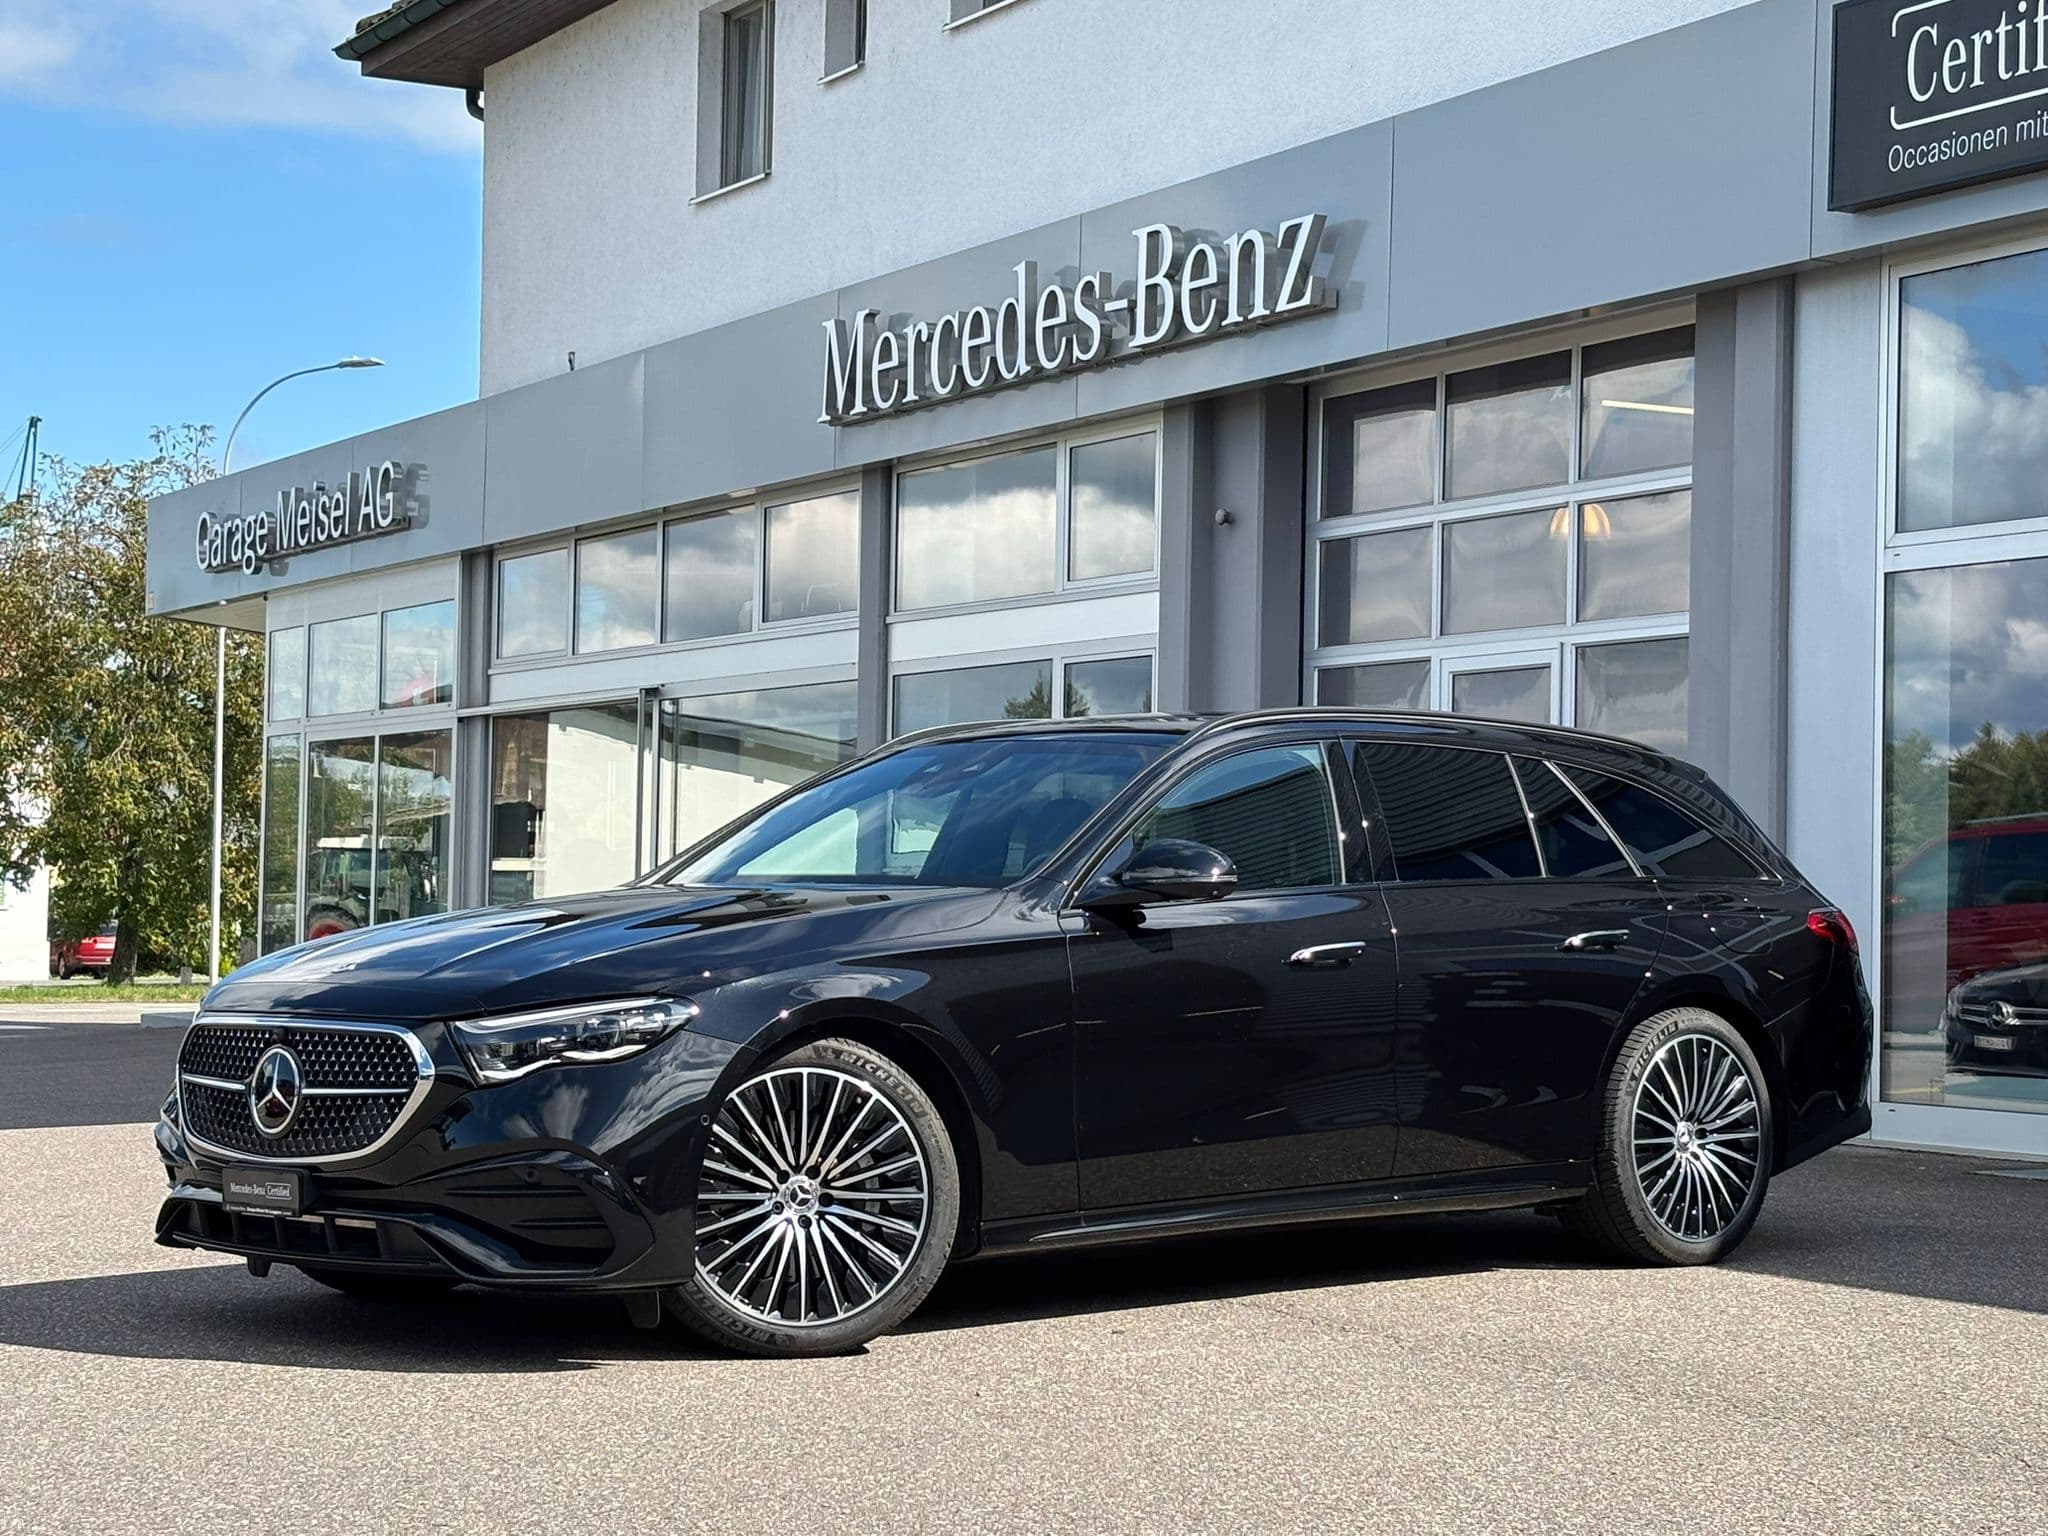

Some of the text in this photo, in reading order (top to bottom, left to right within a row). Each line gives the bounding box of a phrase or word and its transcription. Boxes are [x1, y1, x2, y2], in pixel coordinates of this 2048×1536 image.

[1888, 110, 2048, 172] Occasionen mit
[817, 213, 1320, 424] Mercedes-Benz
[196, 460, 394, 575] Garage Meisel AG
[839, 1050, 923, 1114] MICHELIN
[1631, 1021, 1678, 1079] MICHELIN
